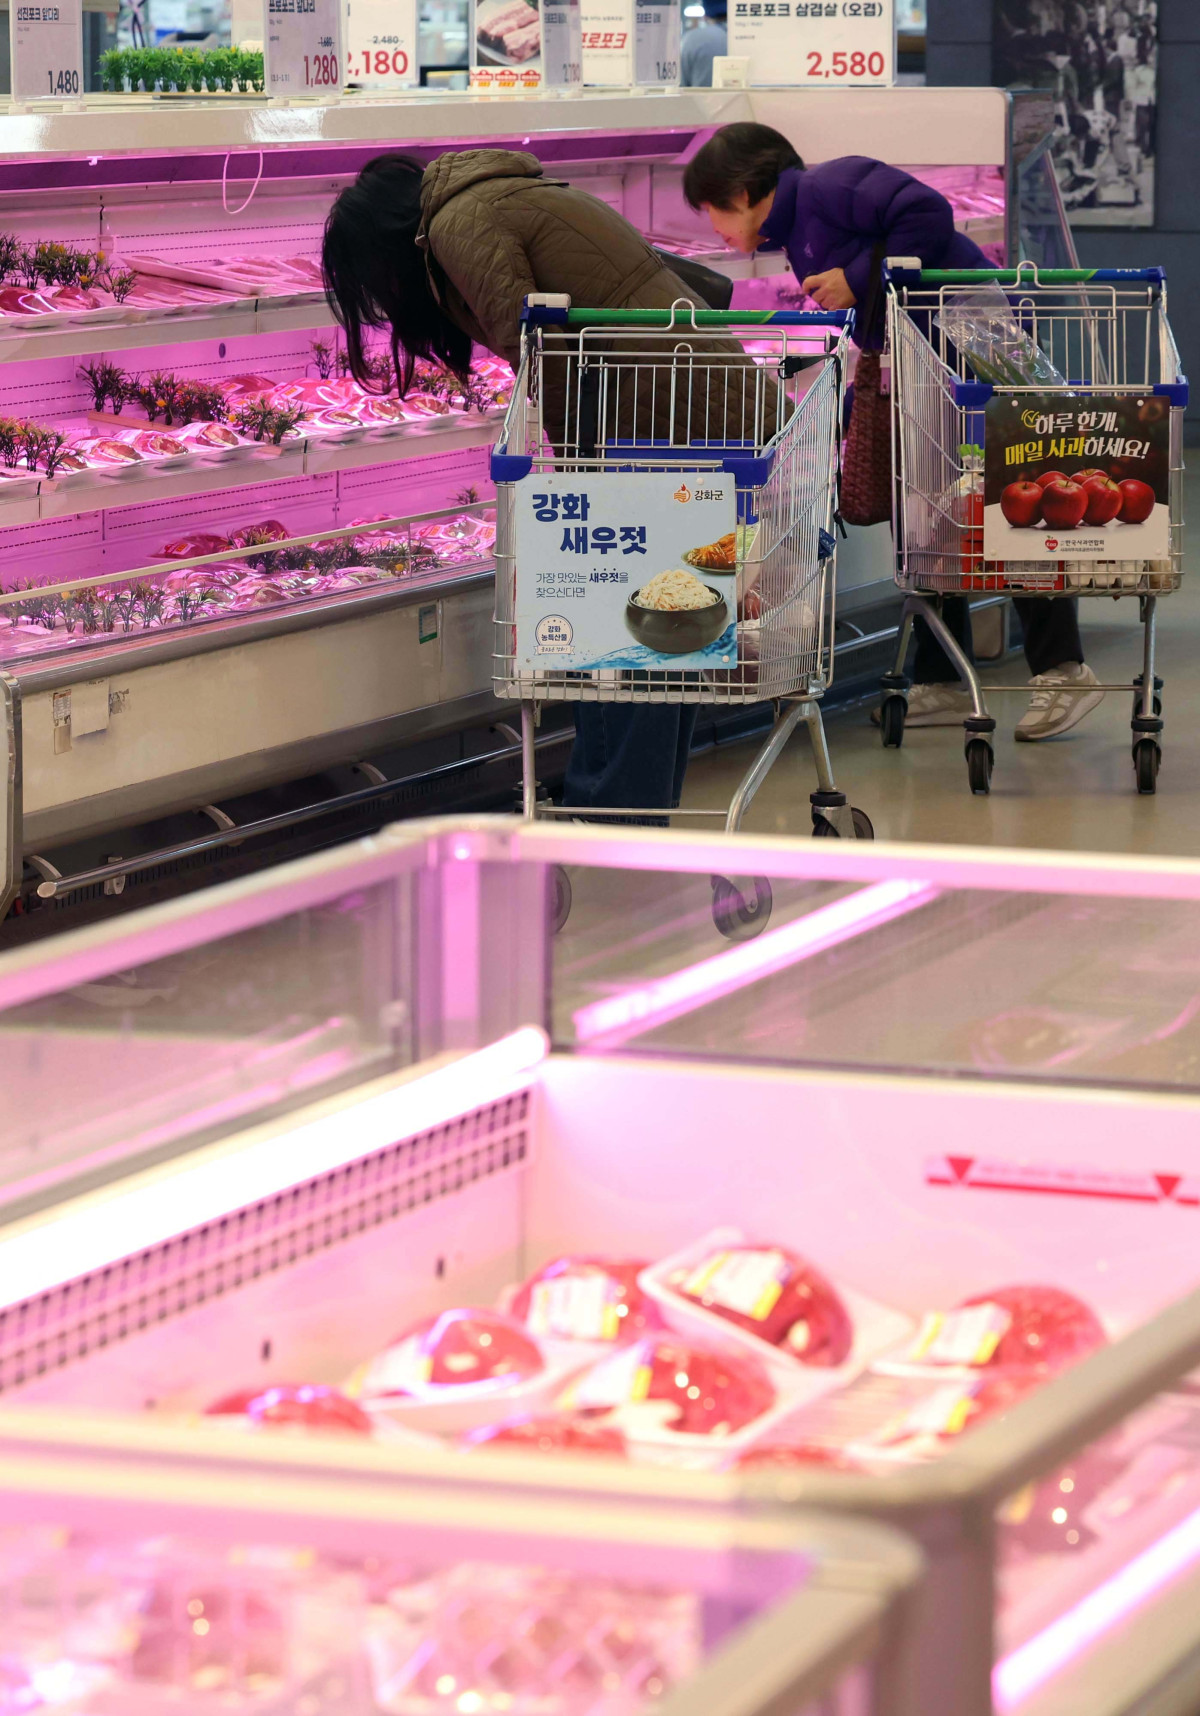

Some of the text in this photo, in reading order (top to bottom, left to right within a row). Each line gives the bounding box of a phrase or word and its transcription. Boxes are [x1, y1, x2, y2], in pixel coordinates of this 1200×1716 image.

[17, 7, 41, 20] 선진포크
[735, 3, 884, 17] 프로포크 삼겹살 (오겹)
[303, 54, 338, 88] 1,280
[806, 51, 885, 78] 2,580
[48, 69, 79, 96] 1,480
[1035, 411, 1120, 435] 하루 한개,
[1005, 436, 1151, 466] 매일 사과하세요!
[694, 489, 724, 501] 강화군
[532, 493, 590, 522] 강화
[560, 526, 648, 555] 새우젓
[536, 571, 629, 584] 가장 맛있는 새우젓을
[536, 587, 586, 598] 찾으신다면
[547, 625, 561, 633] 강화
